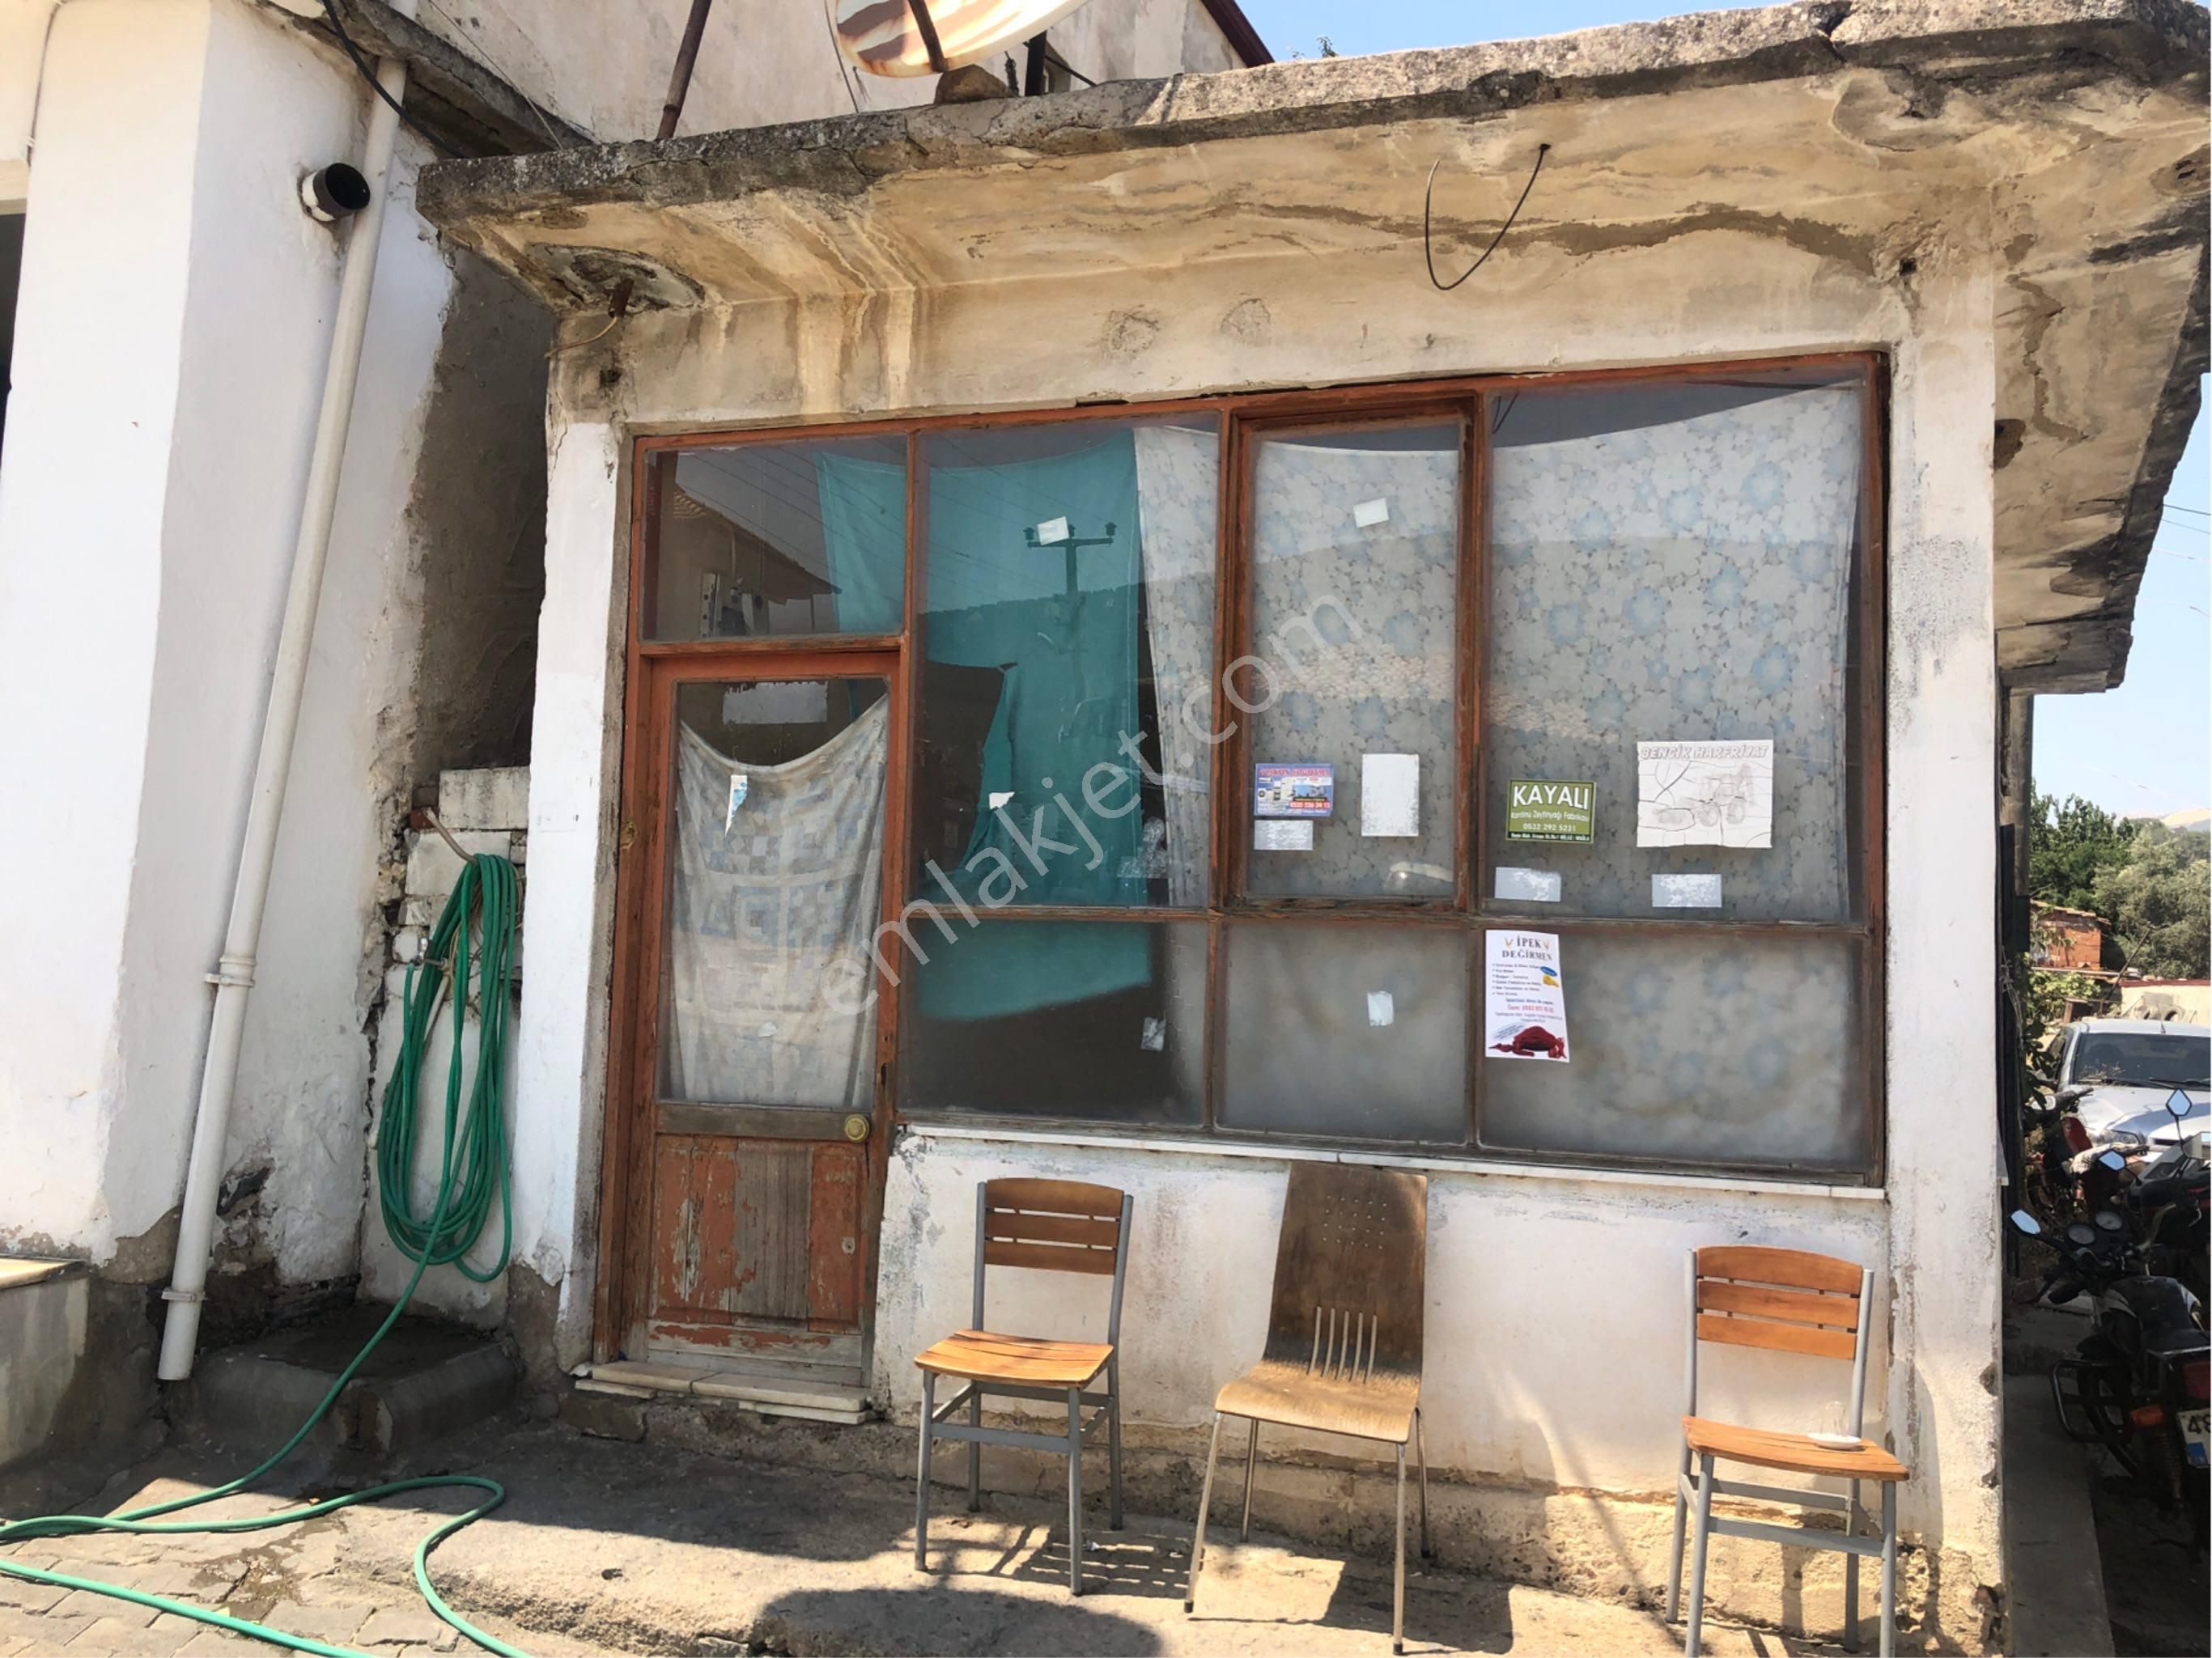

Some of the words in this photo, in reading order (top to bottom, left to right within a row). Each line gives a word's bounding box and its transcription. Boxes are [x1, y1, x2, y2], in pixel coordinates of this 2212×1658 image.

[1513, 785, 1589, 810] KAYALI
[1517, 935, 1542, 948] İPEK
[1502, 949, 1552, 961] DEĞİRMEN
